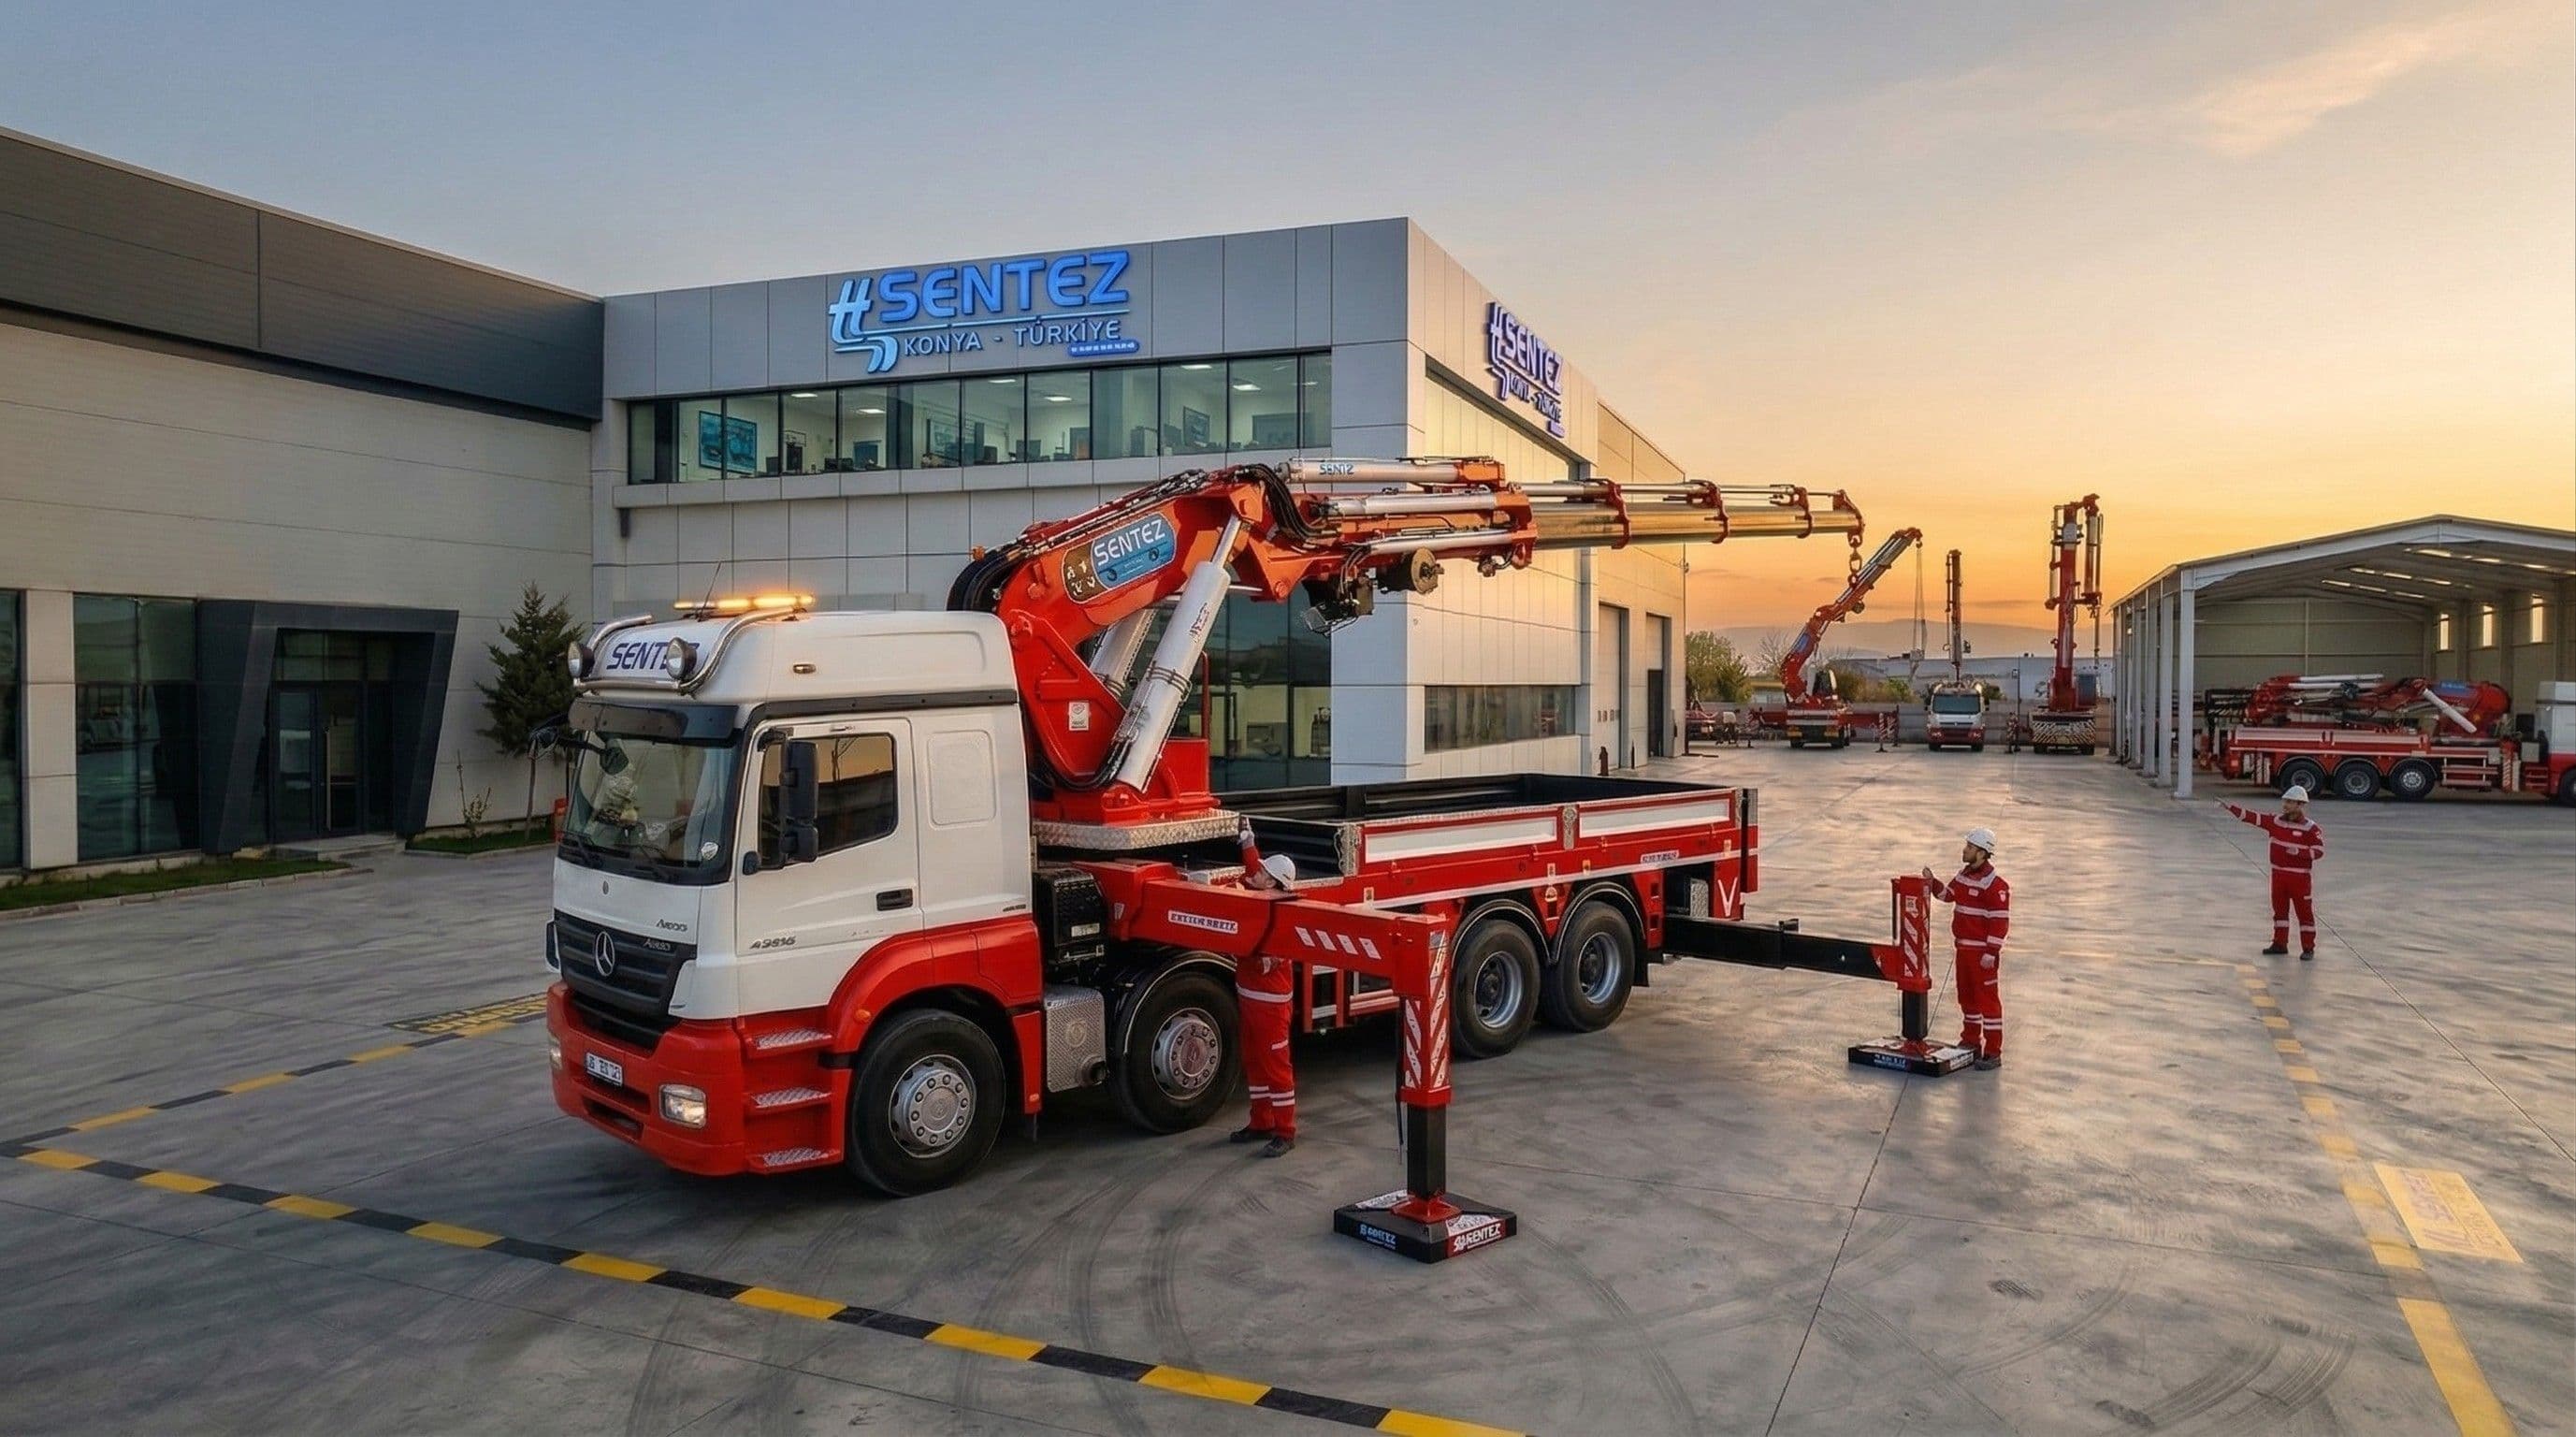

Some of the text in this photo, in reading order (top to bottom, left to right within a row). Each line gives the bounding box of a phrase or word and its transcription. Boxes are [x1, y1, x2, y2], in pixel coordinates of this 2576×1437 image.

[878, 250, 1130, 322] SENTEZ
[904, 331, 982, 356] KONYA
[1014, 318, 1122, 346] TÜRKİYE
[1505, 312, 1563, 396] SENTEZ
[1093, 518, 1166, 567] SENTEZ
[606, 642, 700, 670] SENT
